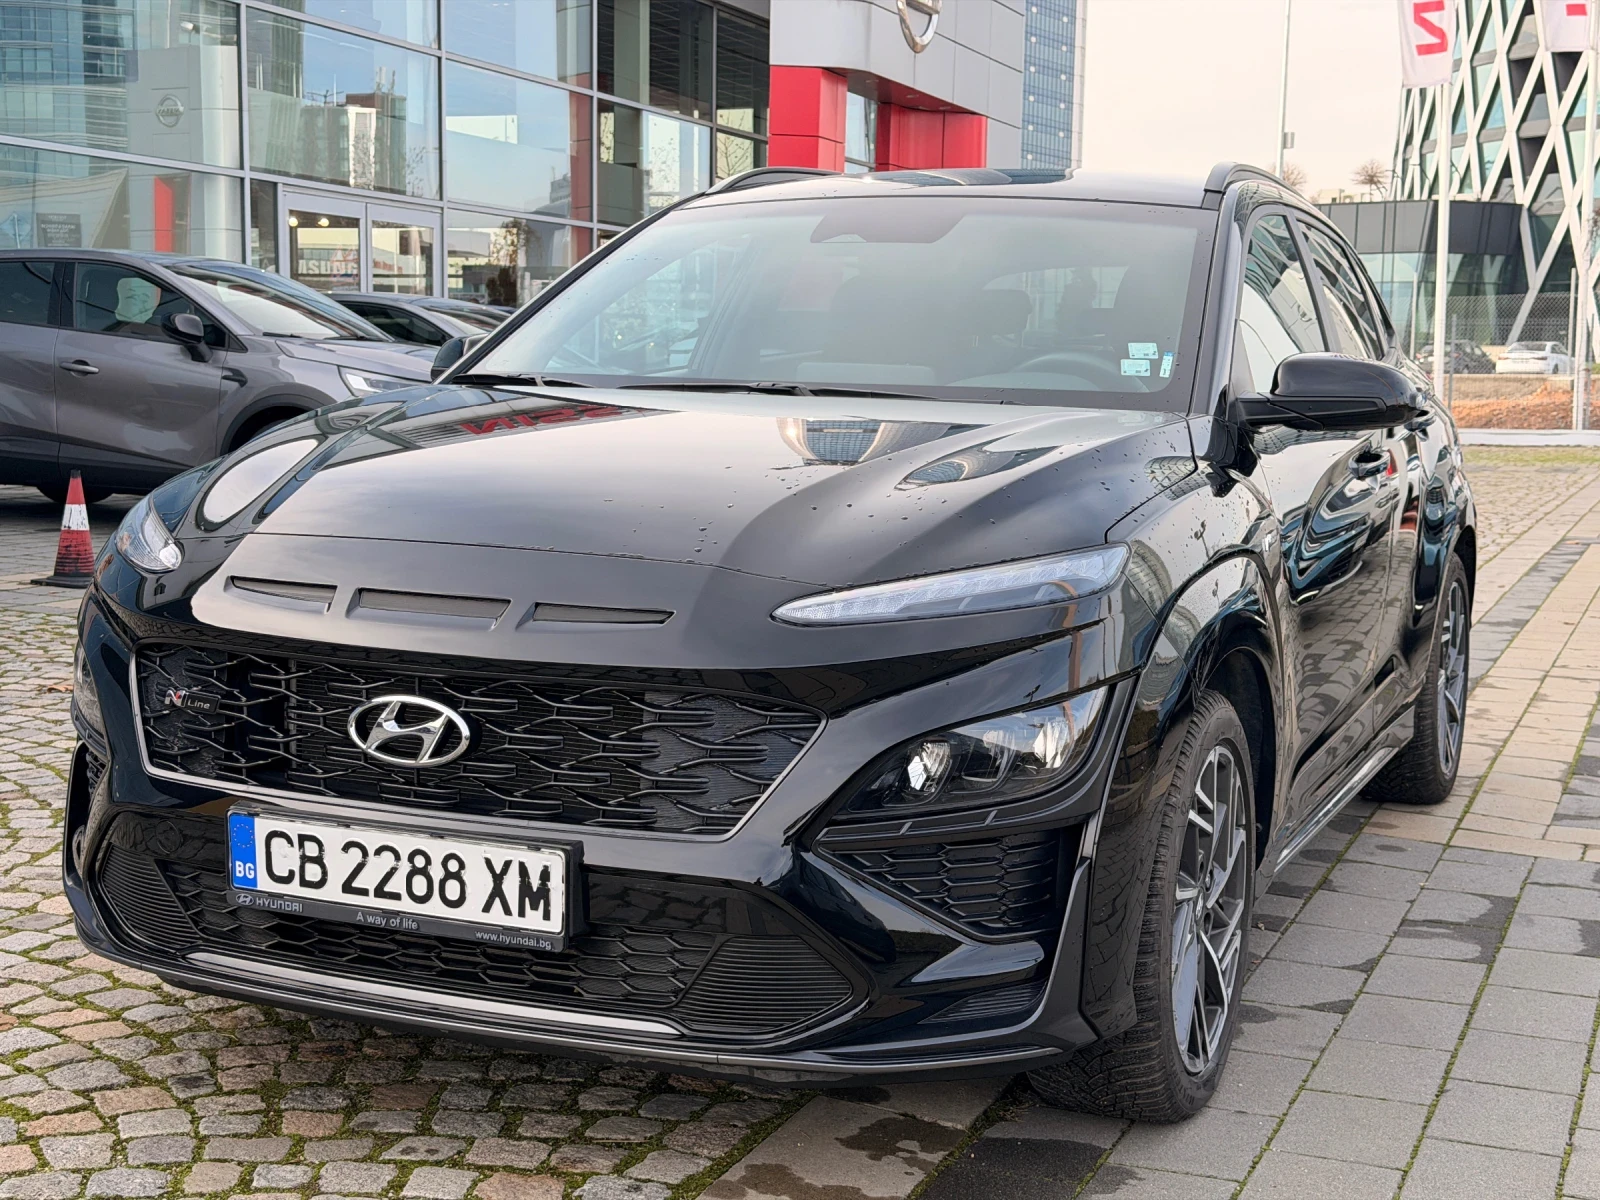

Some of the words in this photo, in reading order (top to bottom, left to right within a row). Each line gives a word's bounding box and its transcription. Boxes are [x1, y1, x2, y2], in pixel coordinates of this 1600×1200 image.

[187, 699, 210, 709] Line
[234, 860, 255, 879] BG
[264, 829, 329, 890] CB
[340, 839, 467, 909] 2288
[481, 855, 551, 922] XM
[256, 897, 303, 912] HYUNDAI
[356, 911, 365, 922] A
[366, 915, 387, 928] way
[390, 916, 401, 927] of
[402, 917, 418, 930] life
[475, 930, 551, 950] www.hyundai.bg
